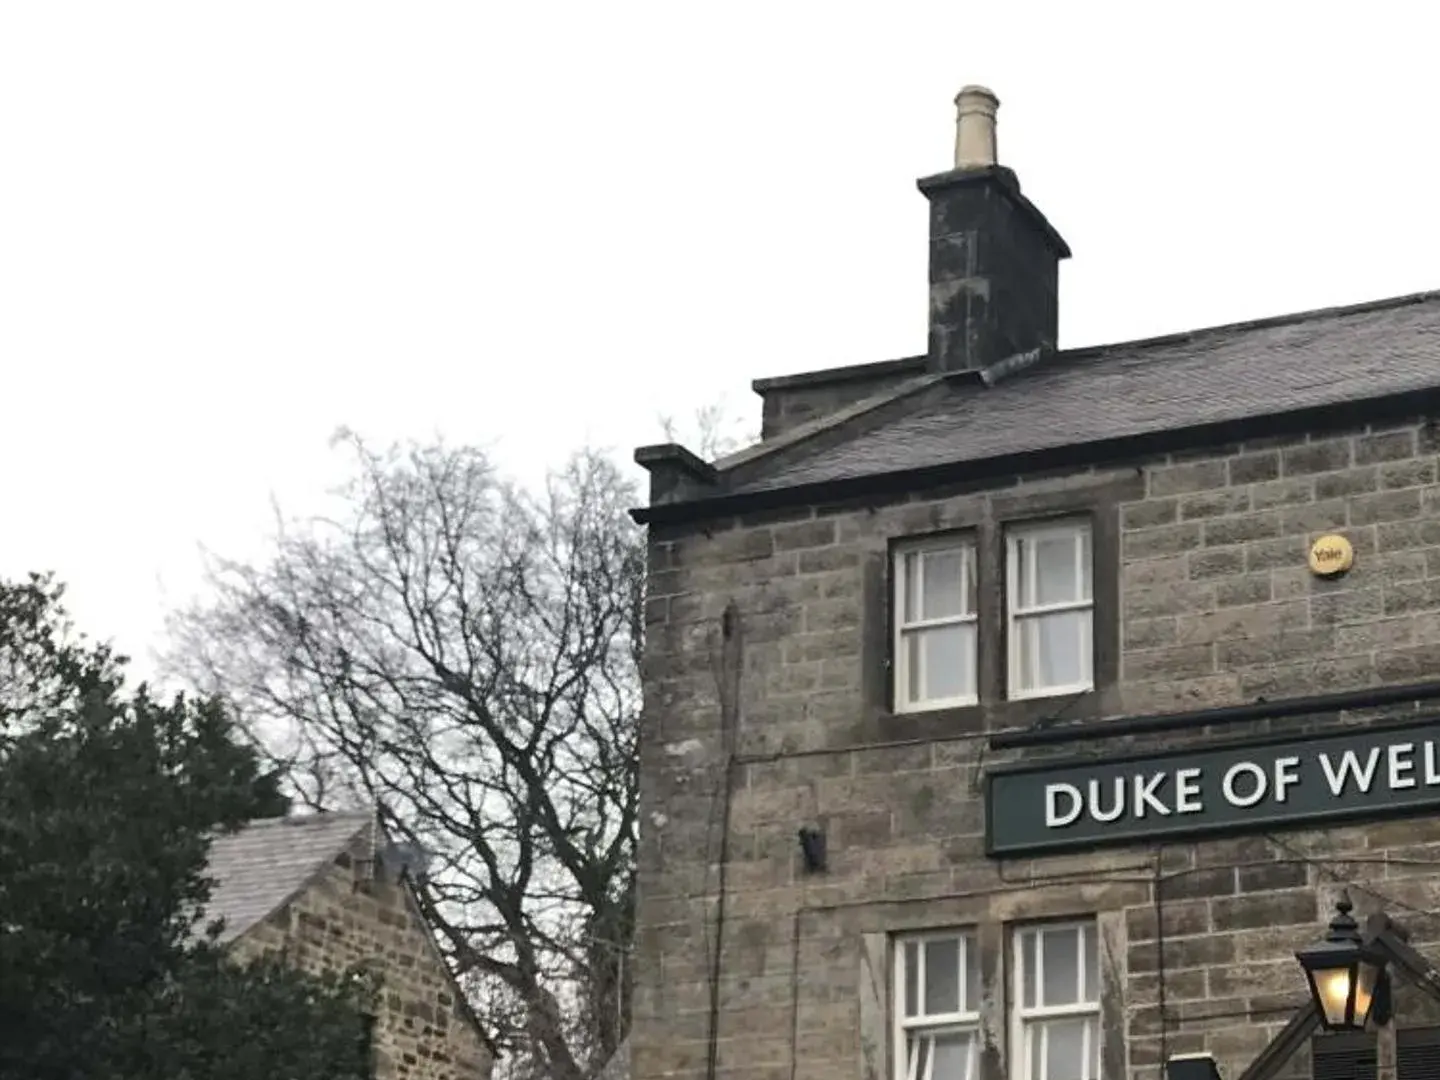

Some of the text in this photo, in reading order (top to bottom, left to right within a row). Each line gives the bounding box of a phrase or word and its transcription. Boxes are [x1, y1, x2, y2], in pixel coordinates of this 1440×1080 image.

[1314, 548, 1342, 562] Yale
[1044, 767, 1203, 828] DUKE
[1221, 756, 1301, 807] OF
